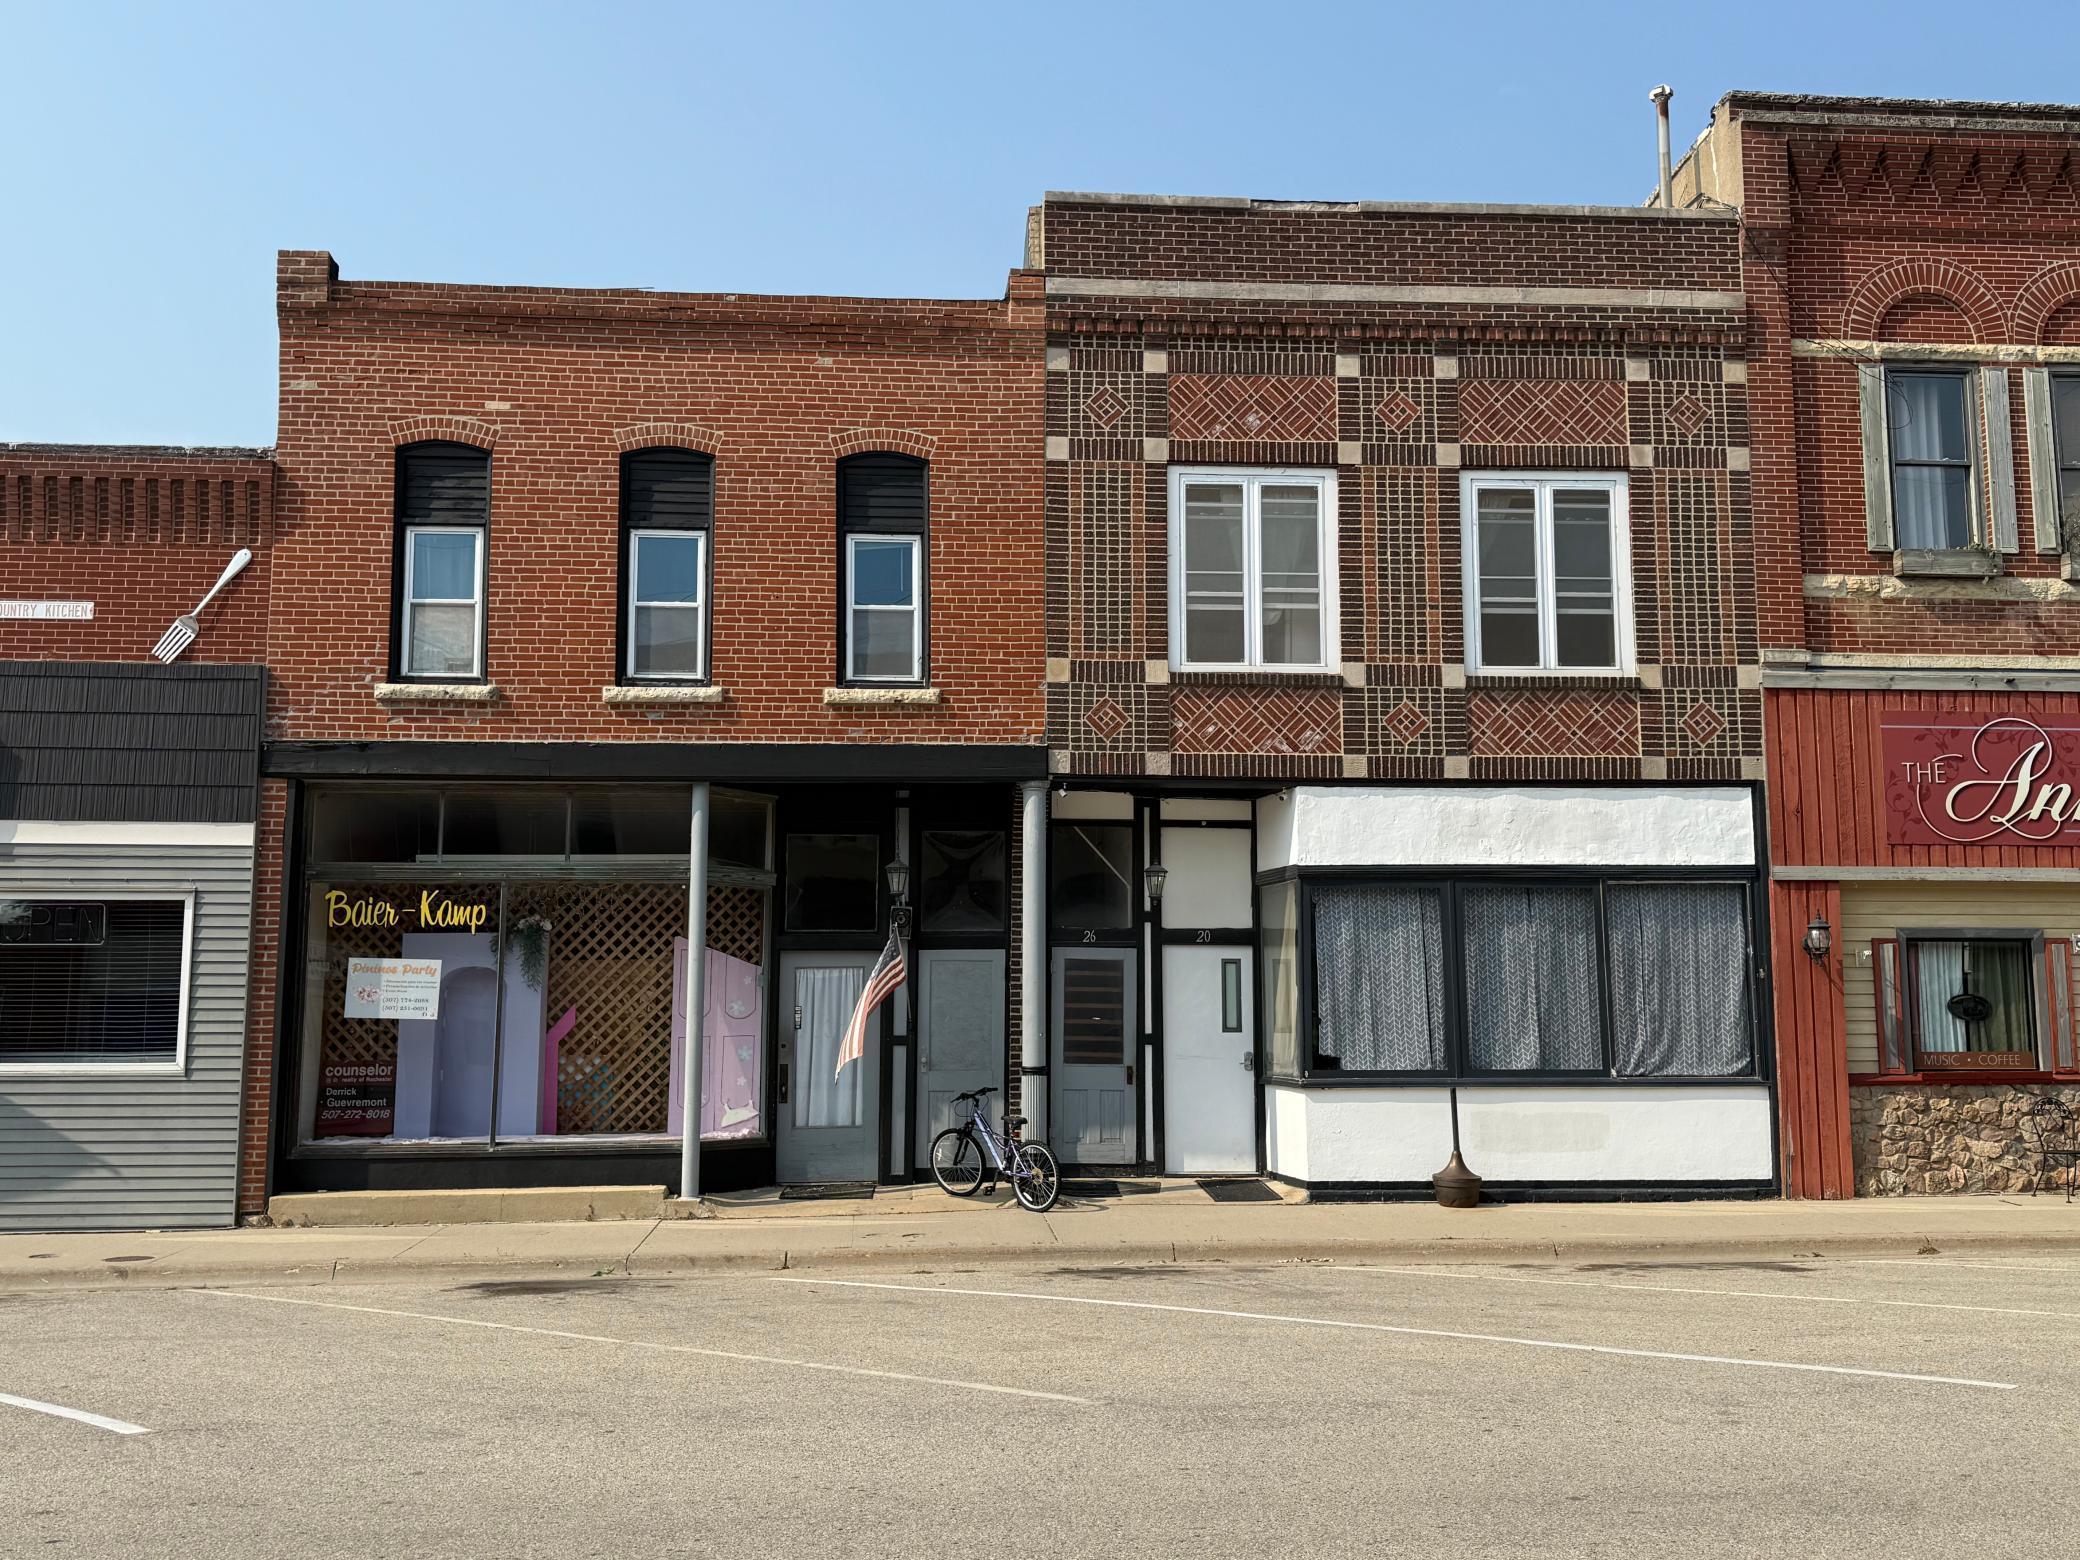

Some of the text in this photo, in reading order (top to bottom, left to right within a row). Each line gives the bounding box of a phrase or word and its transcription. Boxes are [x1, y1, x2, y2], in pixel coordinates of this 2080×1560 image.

[45, 605, 87, 617] KITCHEN
[1902, 717, 2080, 842] THE An
[1083, 930, 1096, 943] 26
[1196, 930, 1211, 943] 20
[402, 964, 438, 977] Party
[1924, 1055, 2020, 1065] MUSIC COFFEE
[325, 1064, 393, 1076] counselor
[326, 1088, 357, 1096] Derrick
[327, 1097, 387, 1107] Guevremont
[321, 1110, 391, 1119] 507-272-8018
